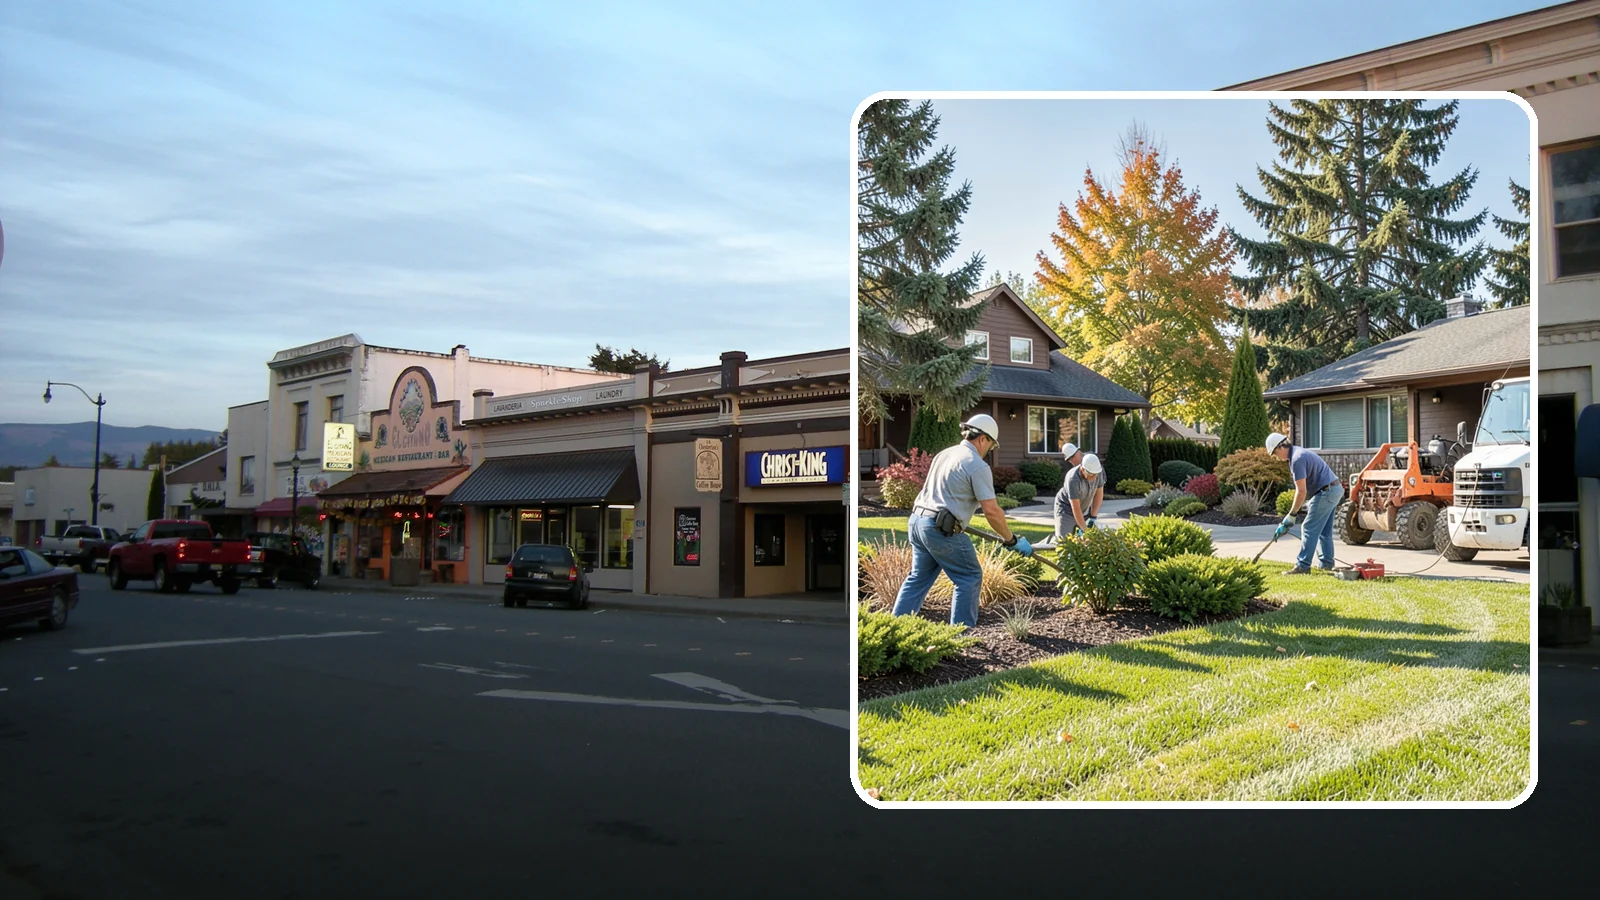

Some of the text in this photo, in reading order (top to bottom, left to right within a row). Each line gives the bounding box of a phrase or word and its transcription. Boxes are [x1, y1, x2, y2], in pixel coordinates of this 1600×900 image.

[530, 394, 582, 409] Sparkle Shop
[595, 389, 623, 400] LAUNDRY
[493, 402, 523, 413] LAVANDERIA
[374, 455, 396, 464] MEXICAN
[397, 452, 433, 463] RESTAURANT
[438, 450, 450, 459] BAR
[761, 450, 827, 477] CHRIST KING
